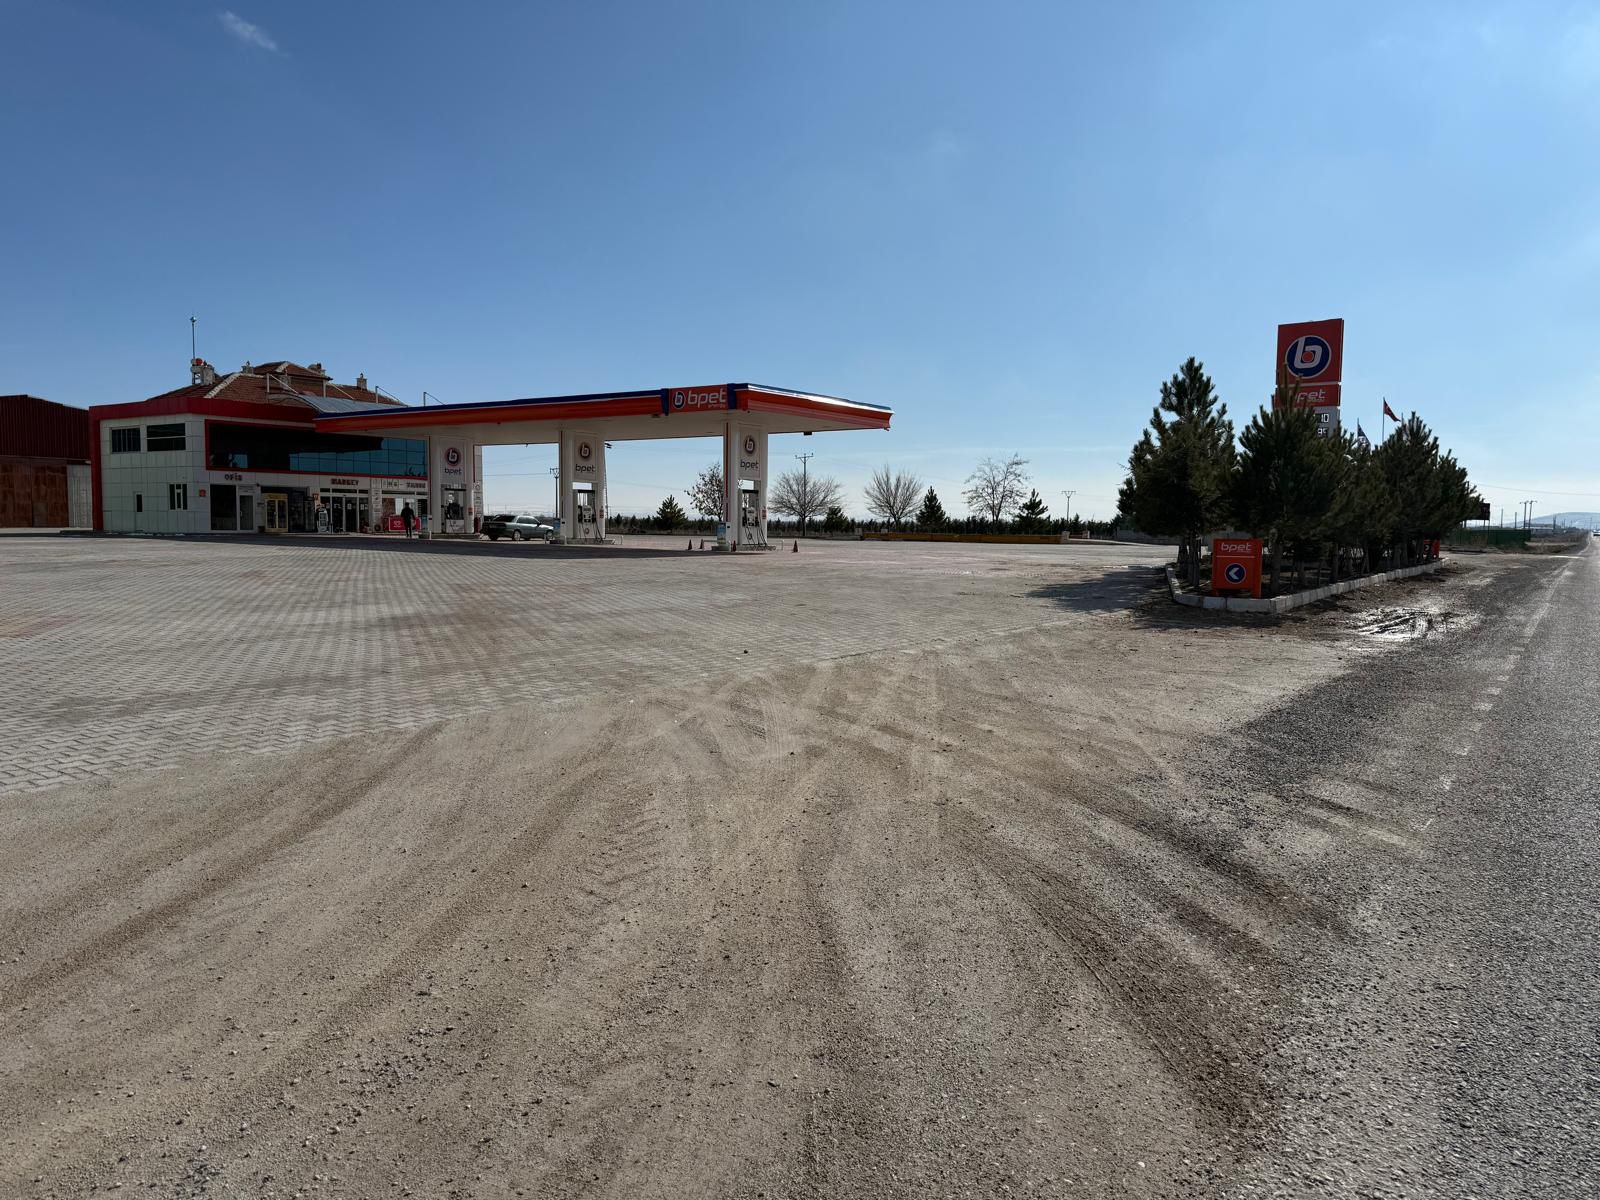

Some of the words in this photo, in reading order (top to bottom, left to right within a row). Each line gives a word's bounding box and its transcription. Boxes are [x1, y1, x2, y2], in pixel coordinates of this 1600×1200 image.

[687, 387, 727, 408] bpet
[575, 463, 596, 473] bpet
[739, 459, 760, 470] bpet
[444, 466, 462, 475] bpet
[330, 478, 360, 486] MARKET
[1220, 542, 1253, 552] bpet
